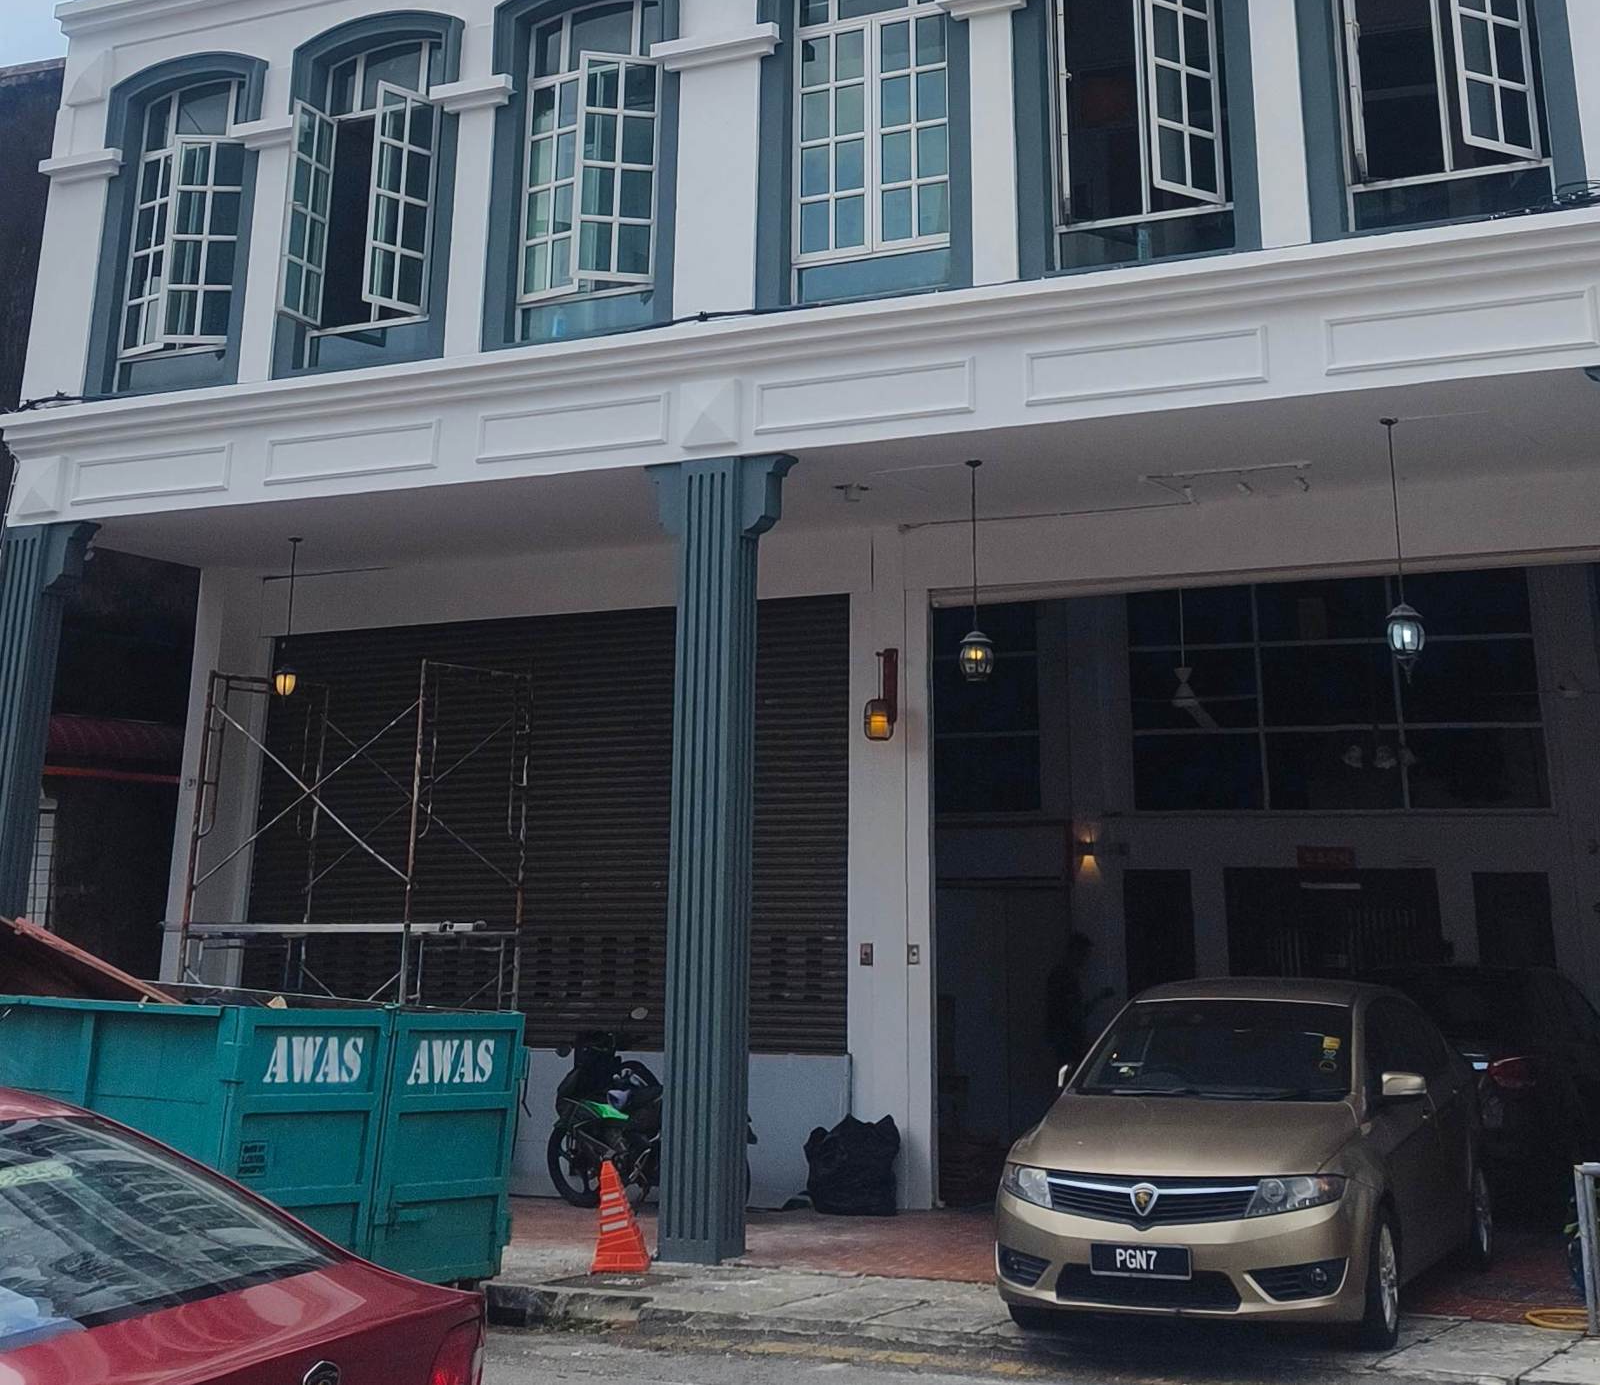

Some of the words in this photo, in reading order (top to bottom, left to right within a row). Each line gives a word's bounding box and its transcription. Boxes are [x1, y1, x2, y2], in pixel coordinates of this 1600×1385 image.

[262, 1036, 364, 1083] AWAS
[406, 1039, 495, 1085] AWAS
[1115, 1248, 1158, 1270] PGN7
